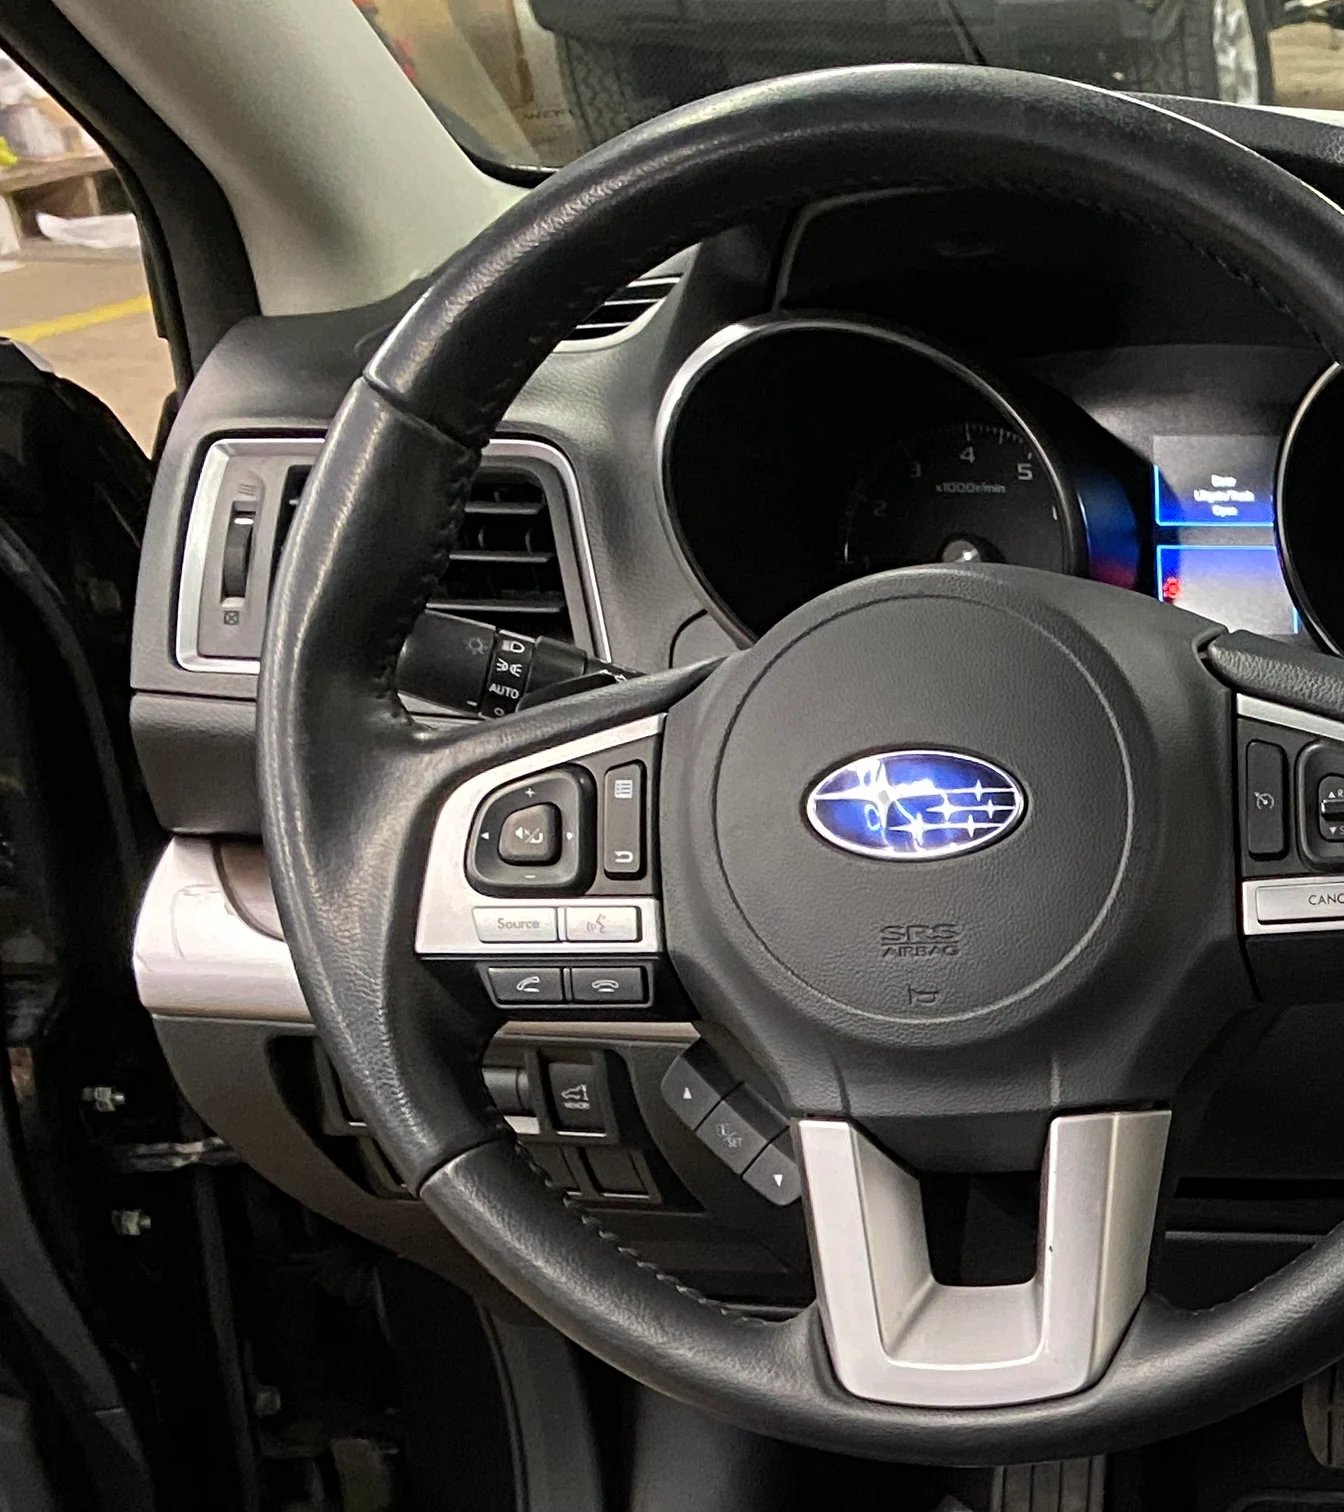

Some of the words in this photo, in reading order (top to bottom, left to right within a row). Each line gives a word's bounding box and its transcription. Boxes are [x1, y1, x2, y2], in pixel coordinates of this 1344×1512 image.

[959, 446, 977, 464] 4
[1016, 463, 1034, 480] 5
[488, 682, 520, 700] AUTO
[497, 917, 540, 929] Source
[880, 923, 961, 941] SRS
[881, 945, 961, 957] AIRBAG
